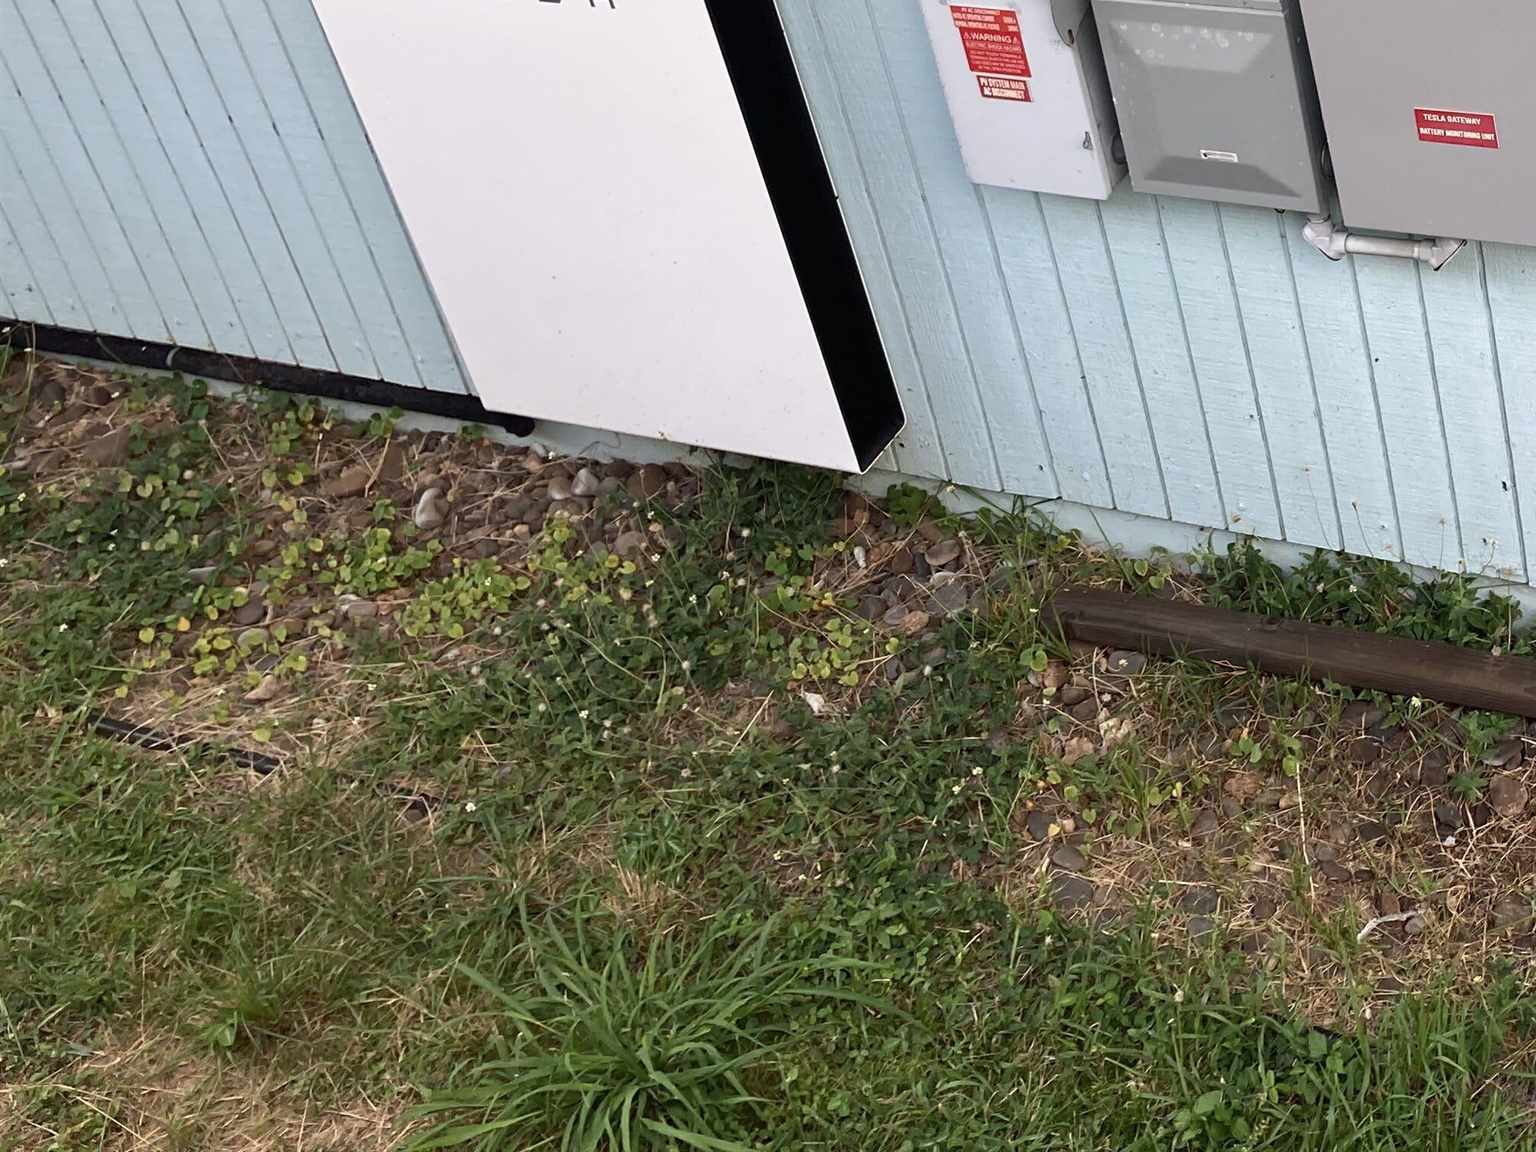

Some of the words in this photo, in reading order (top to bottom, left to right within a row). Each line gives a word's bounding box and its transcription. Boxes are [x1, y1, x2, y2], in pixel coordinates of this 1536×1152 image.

[970, 33, 1011, 43] WARNING
[989, 80, 1010, 88] SYSTEM
[984, 87, 992, 96] AC
[1423, 114, 1447, 122] TESLA
[1447, 116, 1480, 125] GATEWAY
[1420, 127, 1445, 136] BATTERY
[1445, 129, 1481, 139] MONITORING
